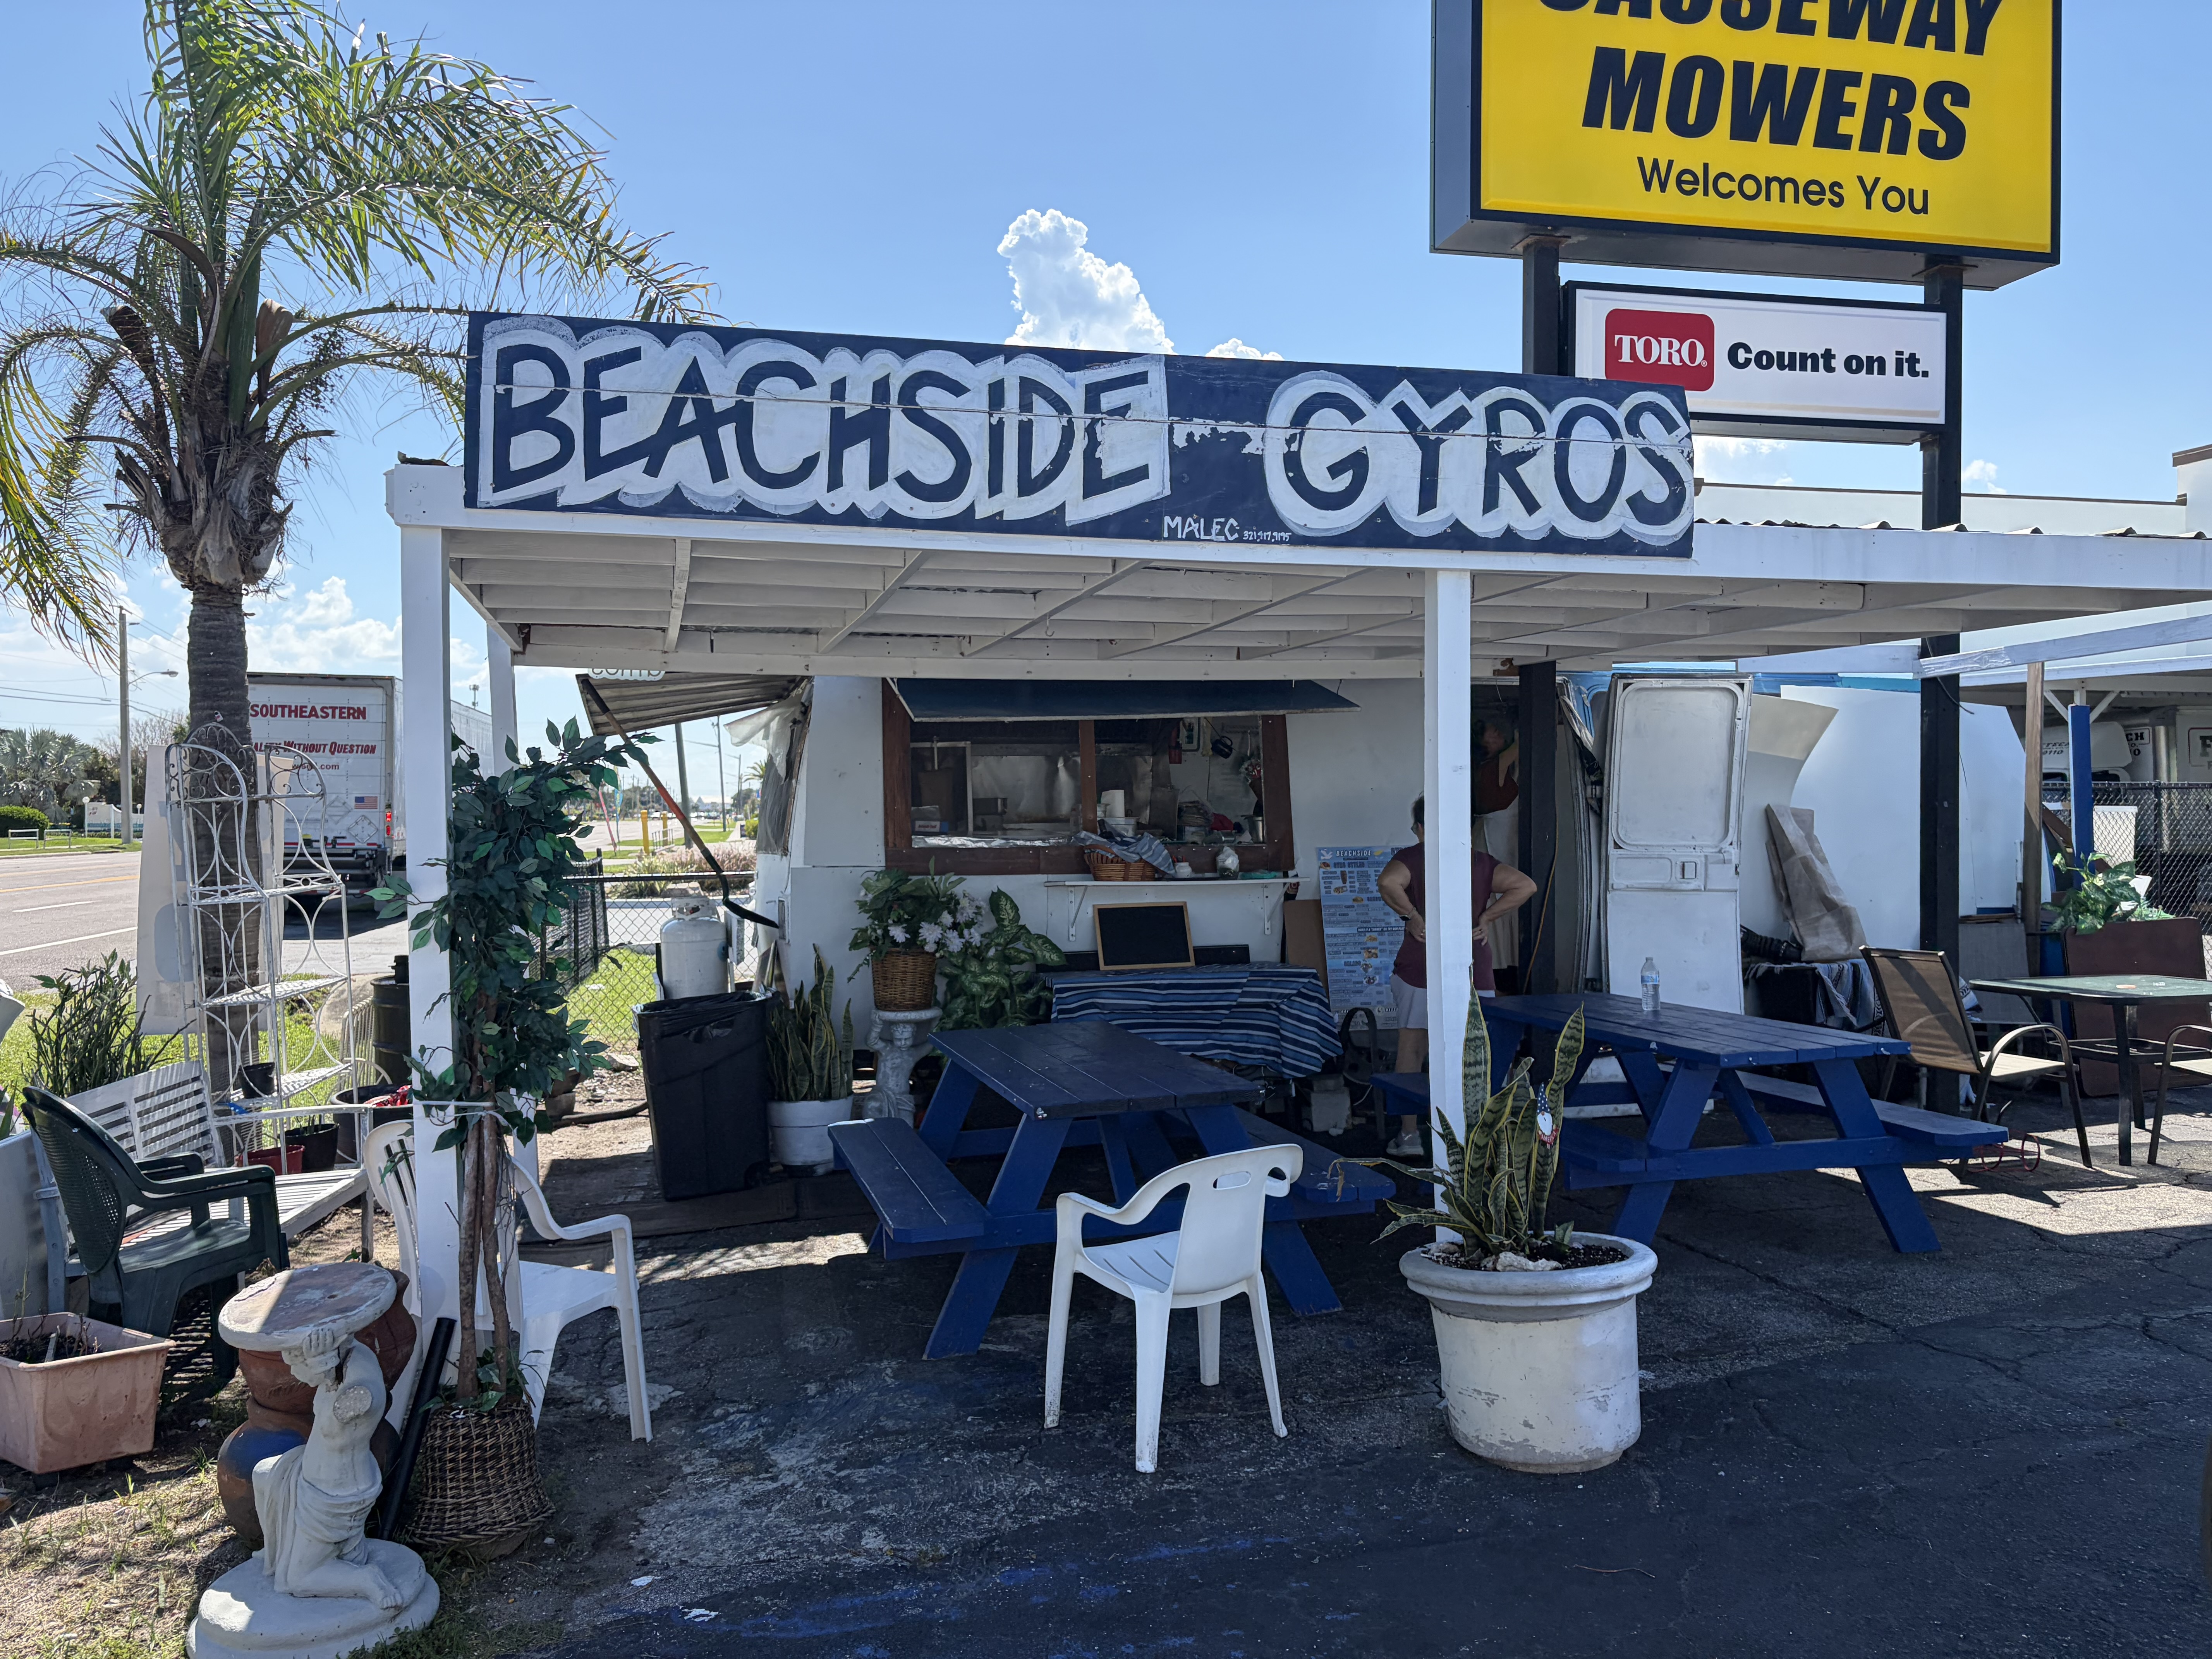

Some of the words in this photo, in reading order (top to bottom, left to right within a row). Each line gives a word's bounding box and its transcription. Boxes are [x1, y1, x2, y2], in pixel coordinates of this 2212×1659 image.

[1582, 46, 1970, 161] MOWERS
[1637, 156, 1844, 208] Welcomes
[1857, 175, 1929, 215] You
[1727, 342, 1836, 372] Count
[1844, 354, 1886, 376] on
[1895, 350, 1929, 378] it.
[493, 342, 1152, 503] BEACHSIDE
[1283, 390, 1688, 527] GYROS
[250, 704, 366, 720] SOUTHEASTERN
[283, 740, 328, 753] WITHOUT
[329, 741, 377, 756] QUESTION
